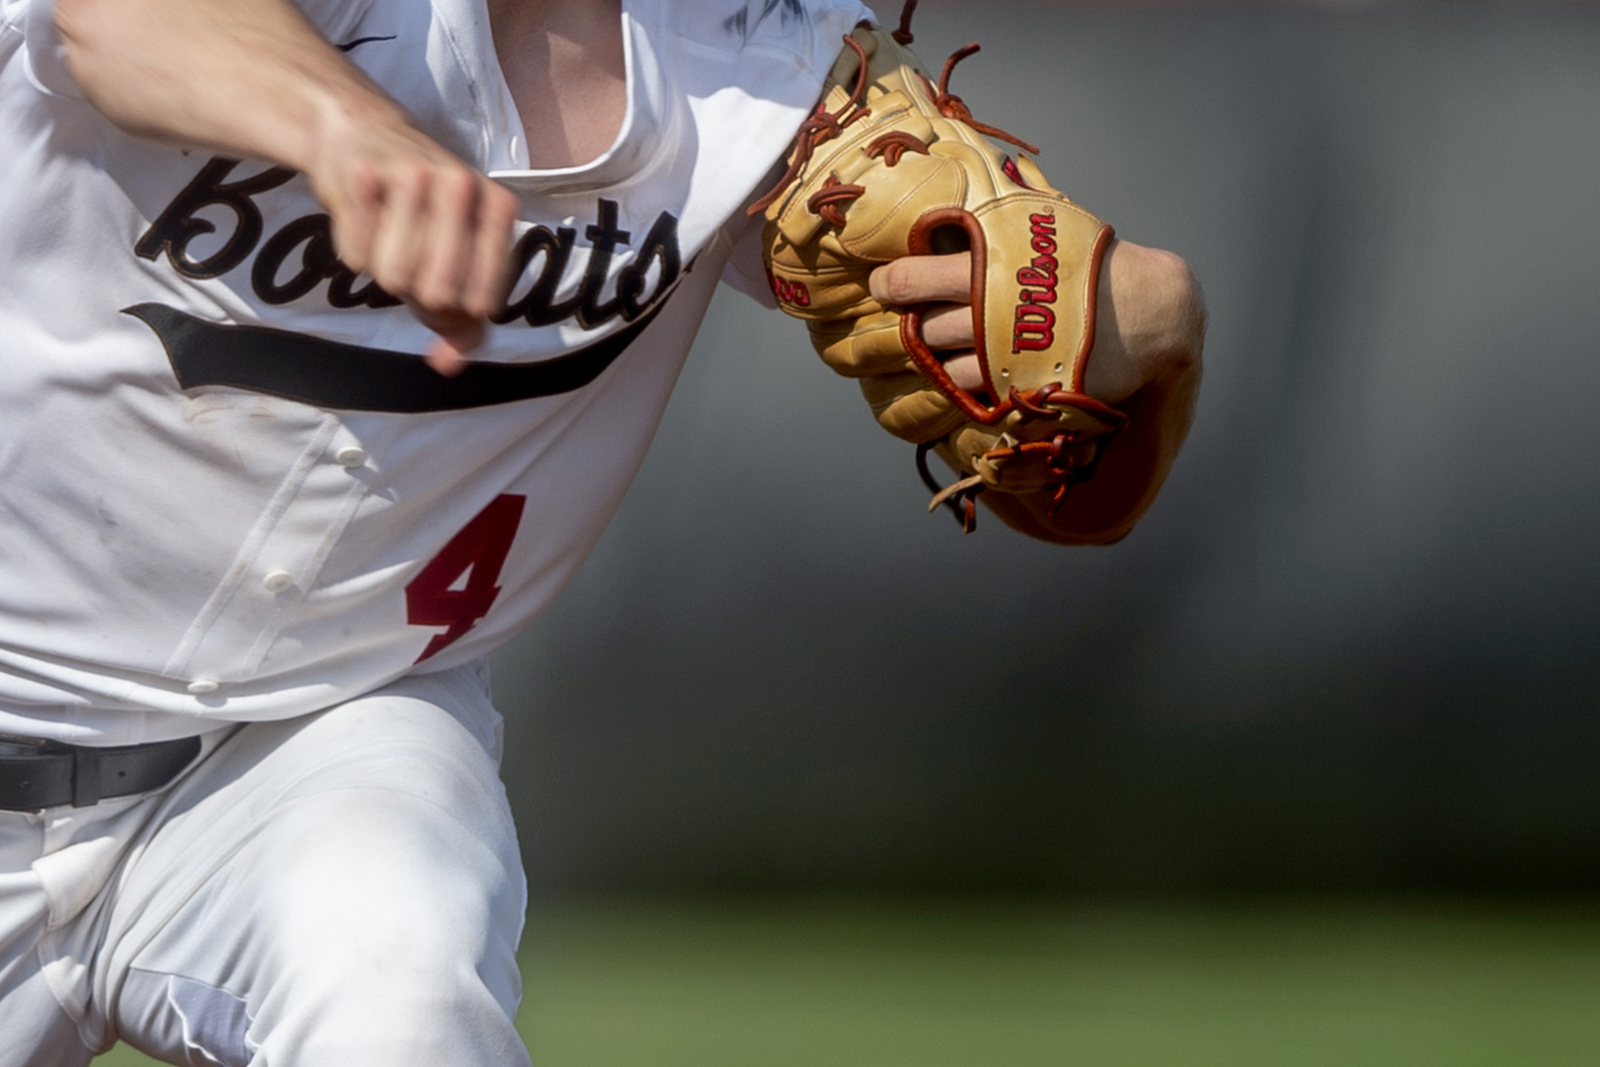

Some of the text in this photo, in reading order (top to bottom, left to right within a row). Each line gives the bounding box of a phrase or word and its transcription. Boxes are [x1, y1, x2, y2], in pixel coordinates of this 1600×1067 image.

[134, 154, 681, 331] Boats
[1012, 213, 1058, 354] Wilson
[404, 493, 527, 666] 4
